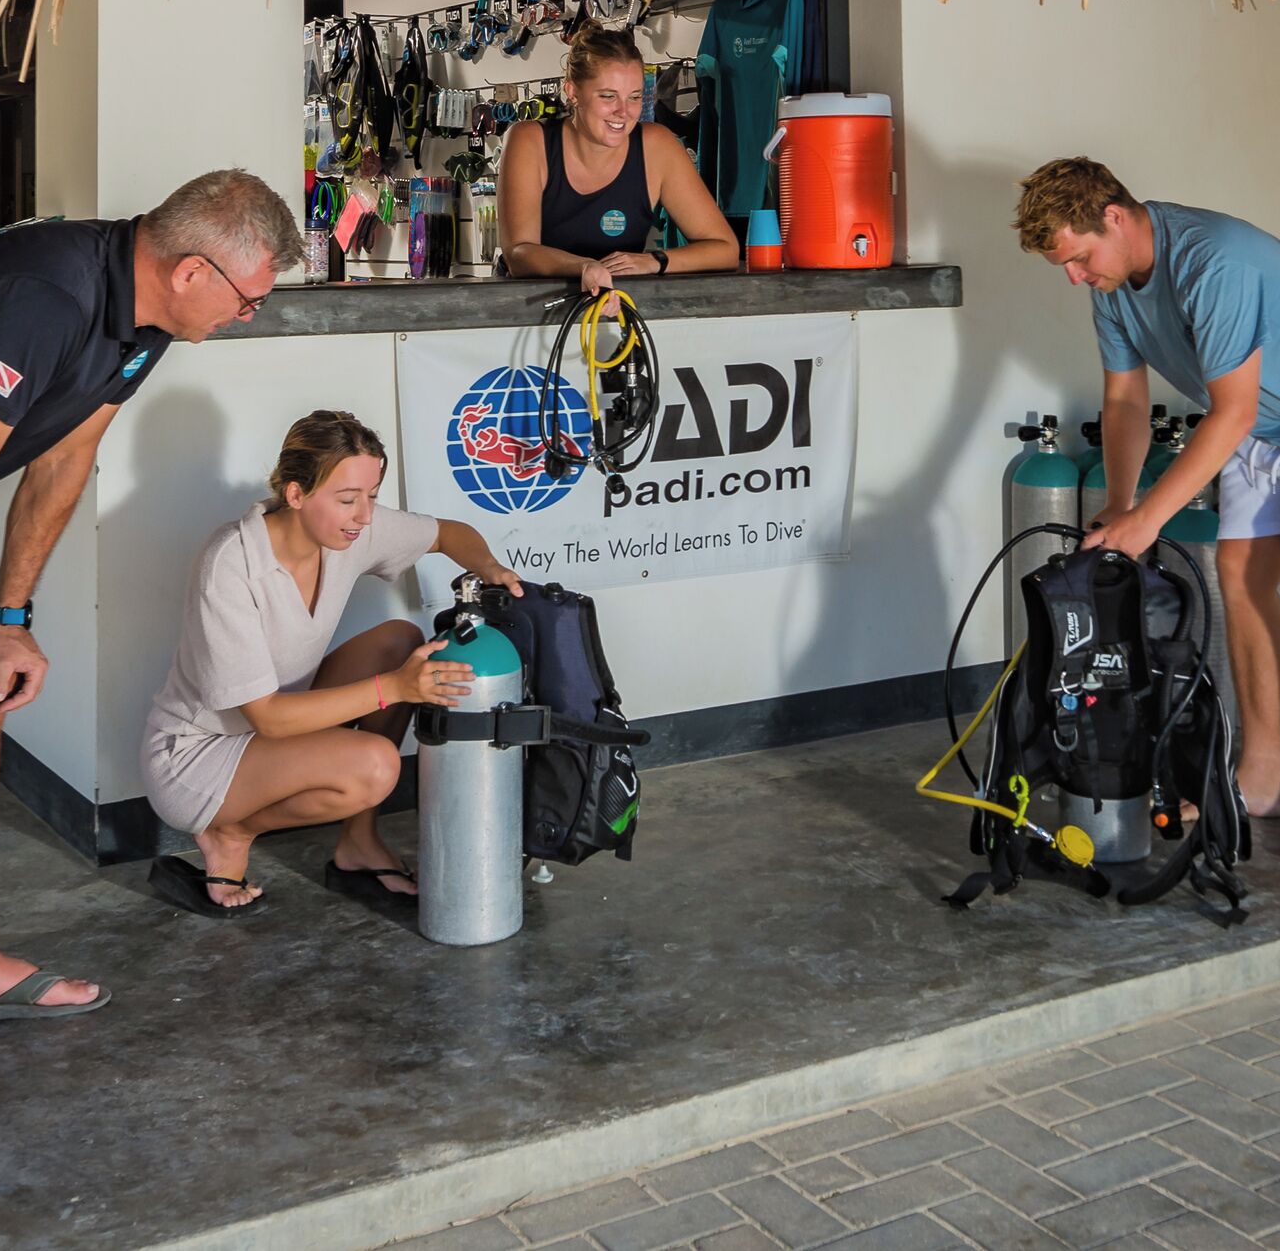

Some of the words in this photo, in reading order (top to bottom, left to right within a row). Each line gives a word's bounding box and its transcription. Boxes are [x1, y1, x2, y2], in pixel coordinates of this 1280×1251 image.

[494, 0, 510, 12] TUSA
[446, 11, 461, 21] TUSA
[541, 83, 558, 95] TUSA
[603, 464, 811, 518] padi.com
[506, 546, 556, 573] Way
[563, 541, 600, 564] The
[608, 532, 668, 560] World
[674, 532, 732, 553] Learns
[738, 524, 758, 545] To
[766, 521, 803, 542] Dive
